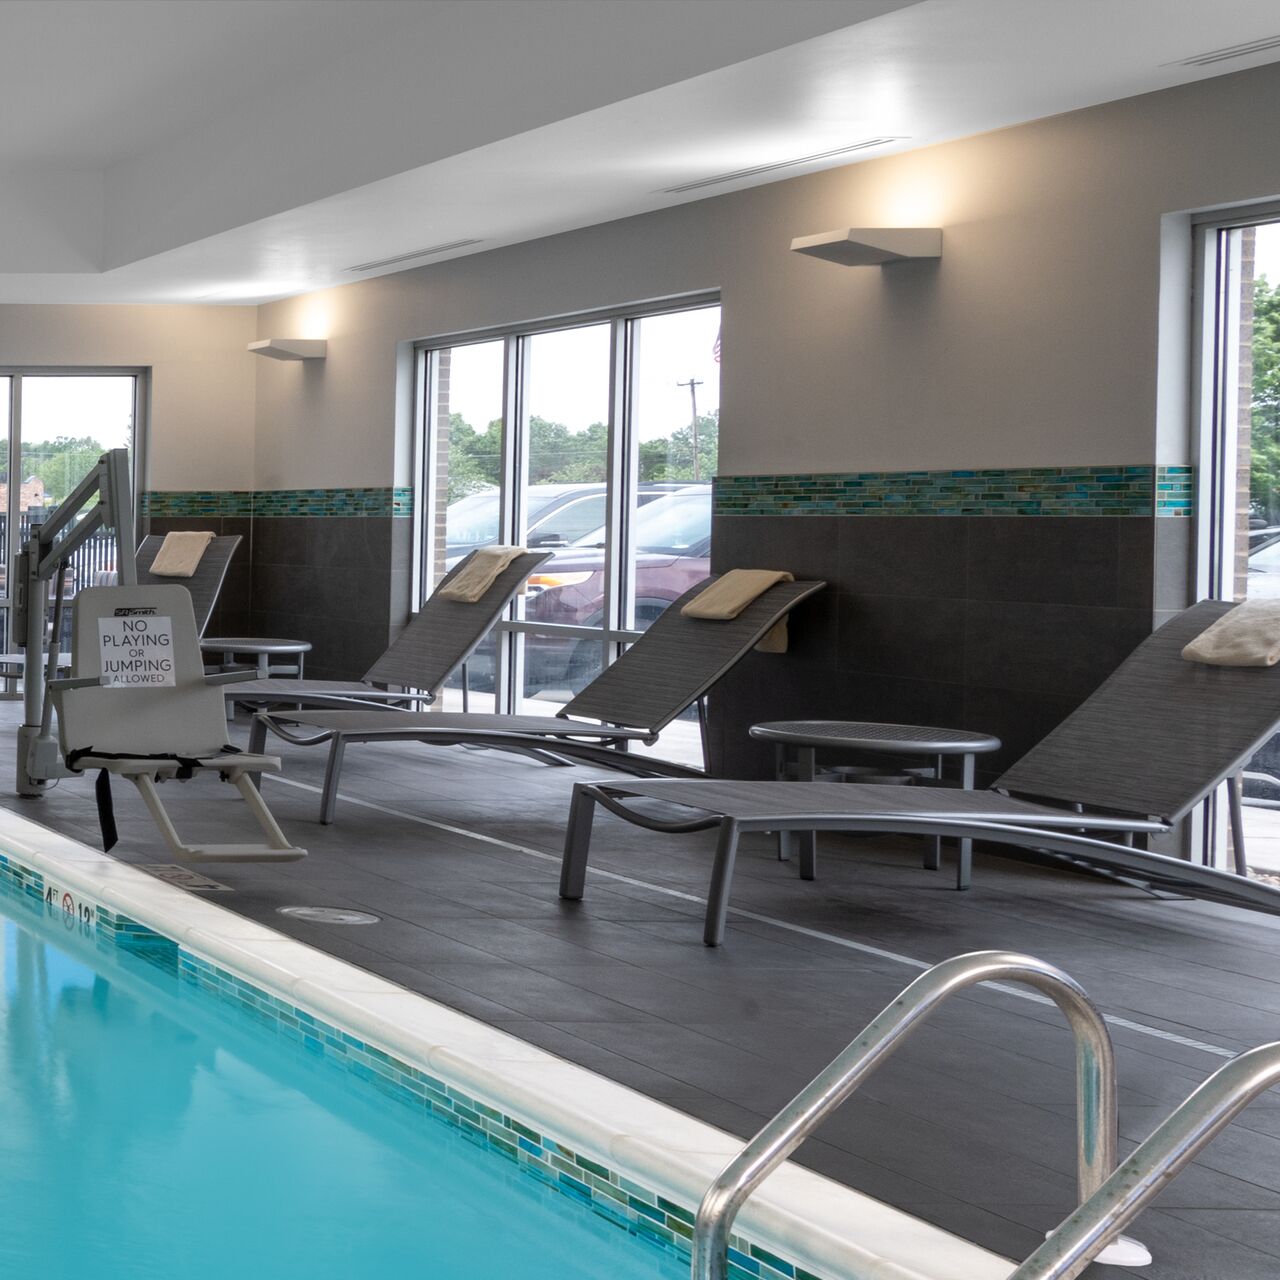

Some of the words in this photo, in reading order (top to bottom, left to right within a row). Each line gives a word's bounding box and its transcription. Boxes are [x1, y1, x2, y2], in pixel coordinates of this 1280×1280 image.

[123, 620, 148, 633] NO
[103, 634, 170, 647] PLAYING
[128, 649, 145, 658] OR
[104, 659, 172, 673] JUMPING
[113, 674, 165, 684] ALLOWED
